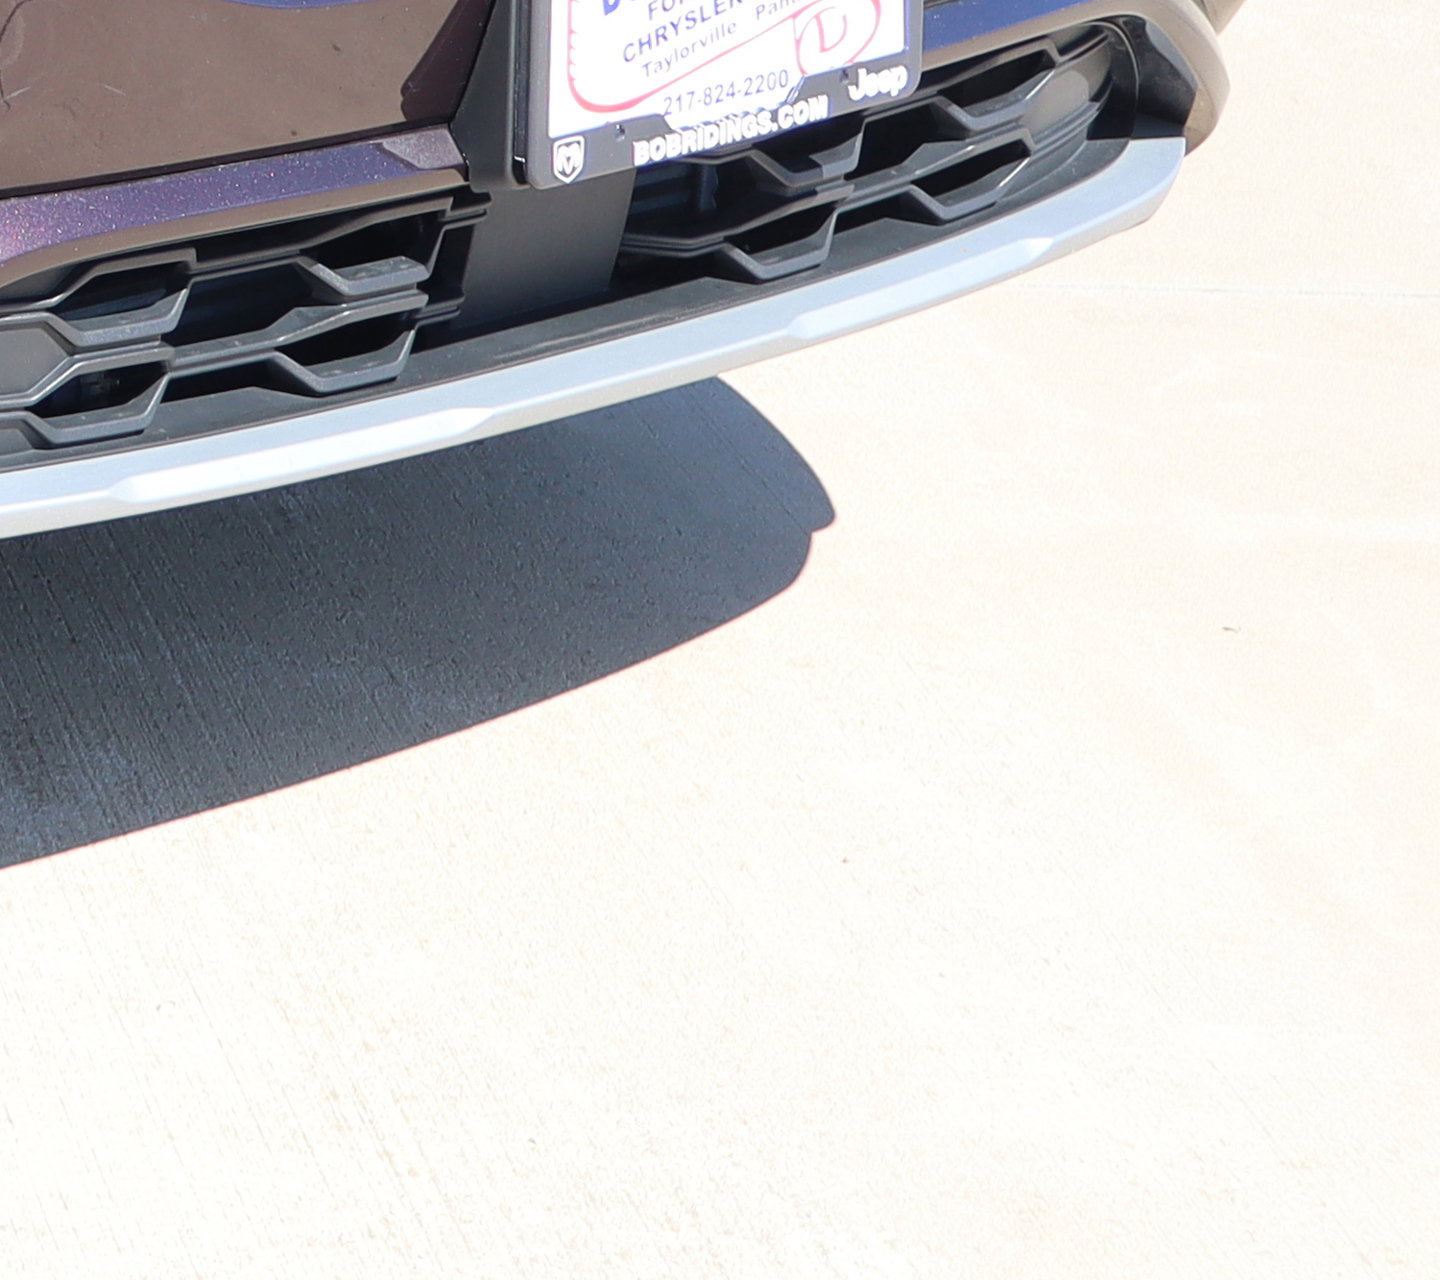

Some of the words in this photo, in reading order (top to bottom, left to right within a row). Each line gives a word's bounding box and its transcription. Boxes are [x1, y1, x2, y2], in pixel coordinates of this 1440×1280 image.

[641, 21, 737, 78] Taylorville
[662, 69, 790, 116] 217-824-2200
[848, 64, 909, 102] Jeep
[633, 94, 830, 167] BOBRIDINGS.COM
